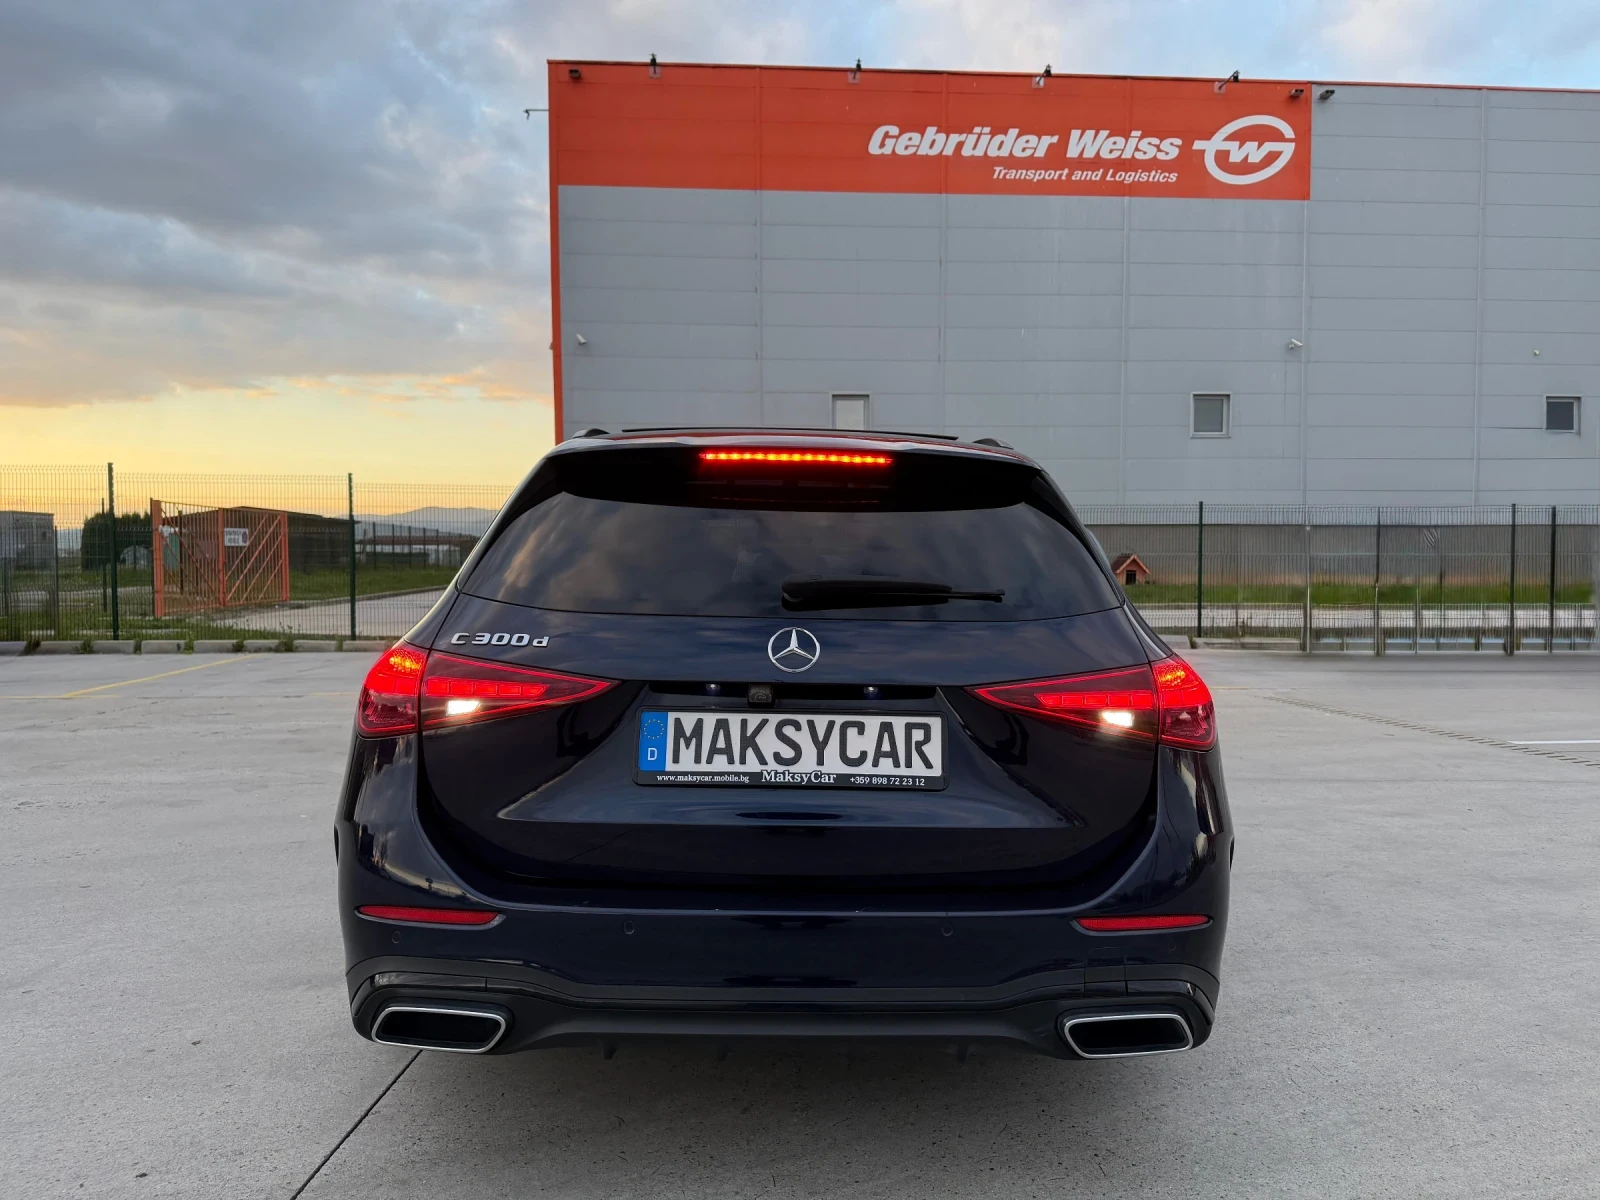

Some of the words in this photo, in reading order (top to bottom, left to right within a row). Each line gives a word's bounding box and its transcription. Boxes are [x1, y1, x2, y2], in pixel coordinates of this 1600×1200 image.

[868, 124, 1059, 158] Gebrüder
[1066, 129, 1183, 160] Weiss
[993, 166, 1069, 182] Transport
[1072, 168, 1104, 181] and
[1106, 169, 1178, 184] Logistics
[451, 633, 470, 646] C
[672, 718, 934, 769] MAKSYCAR
[648, 748, 657, 761] D
[656, 773, 750, 784] www.maksycar.mobile.bg
[761, 770, 837, 784] MaksyCar
[850, 776, 870, 785] +359
[872, 776, 888, 785] 898
[890, 777, 900, 785] 72
[902, 777, 913, 786] 23
[915, 778, 925, 786] 12
